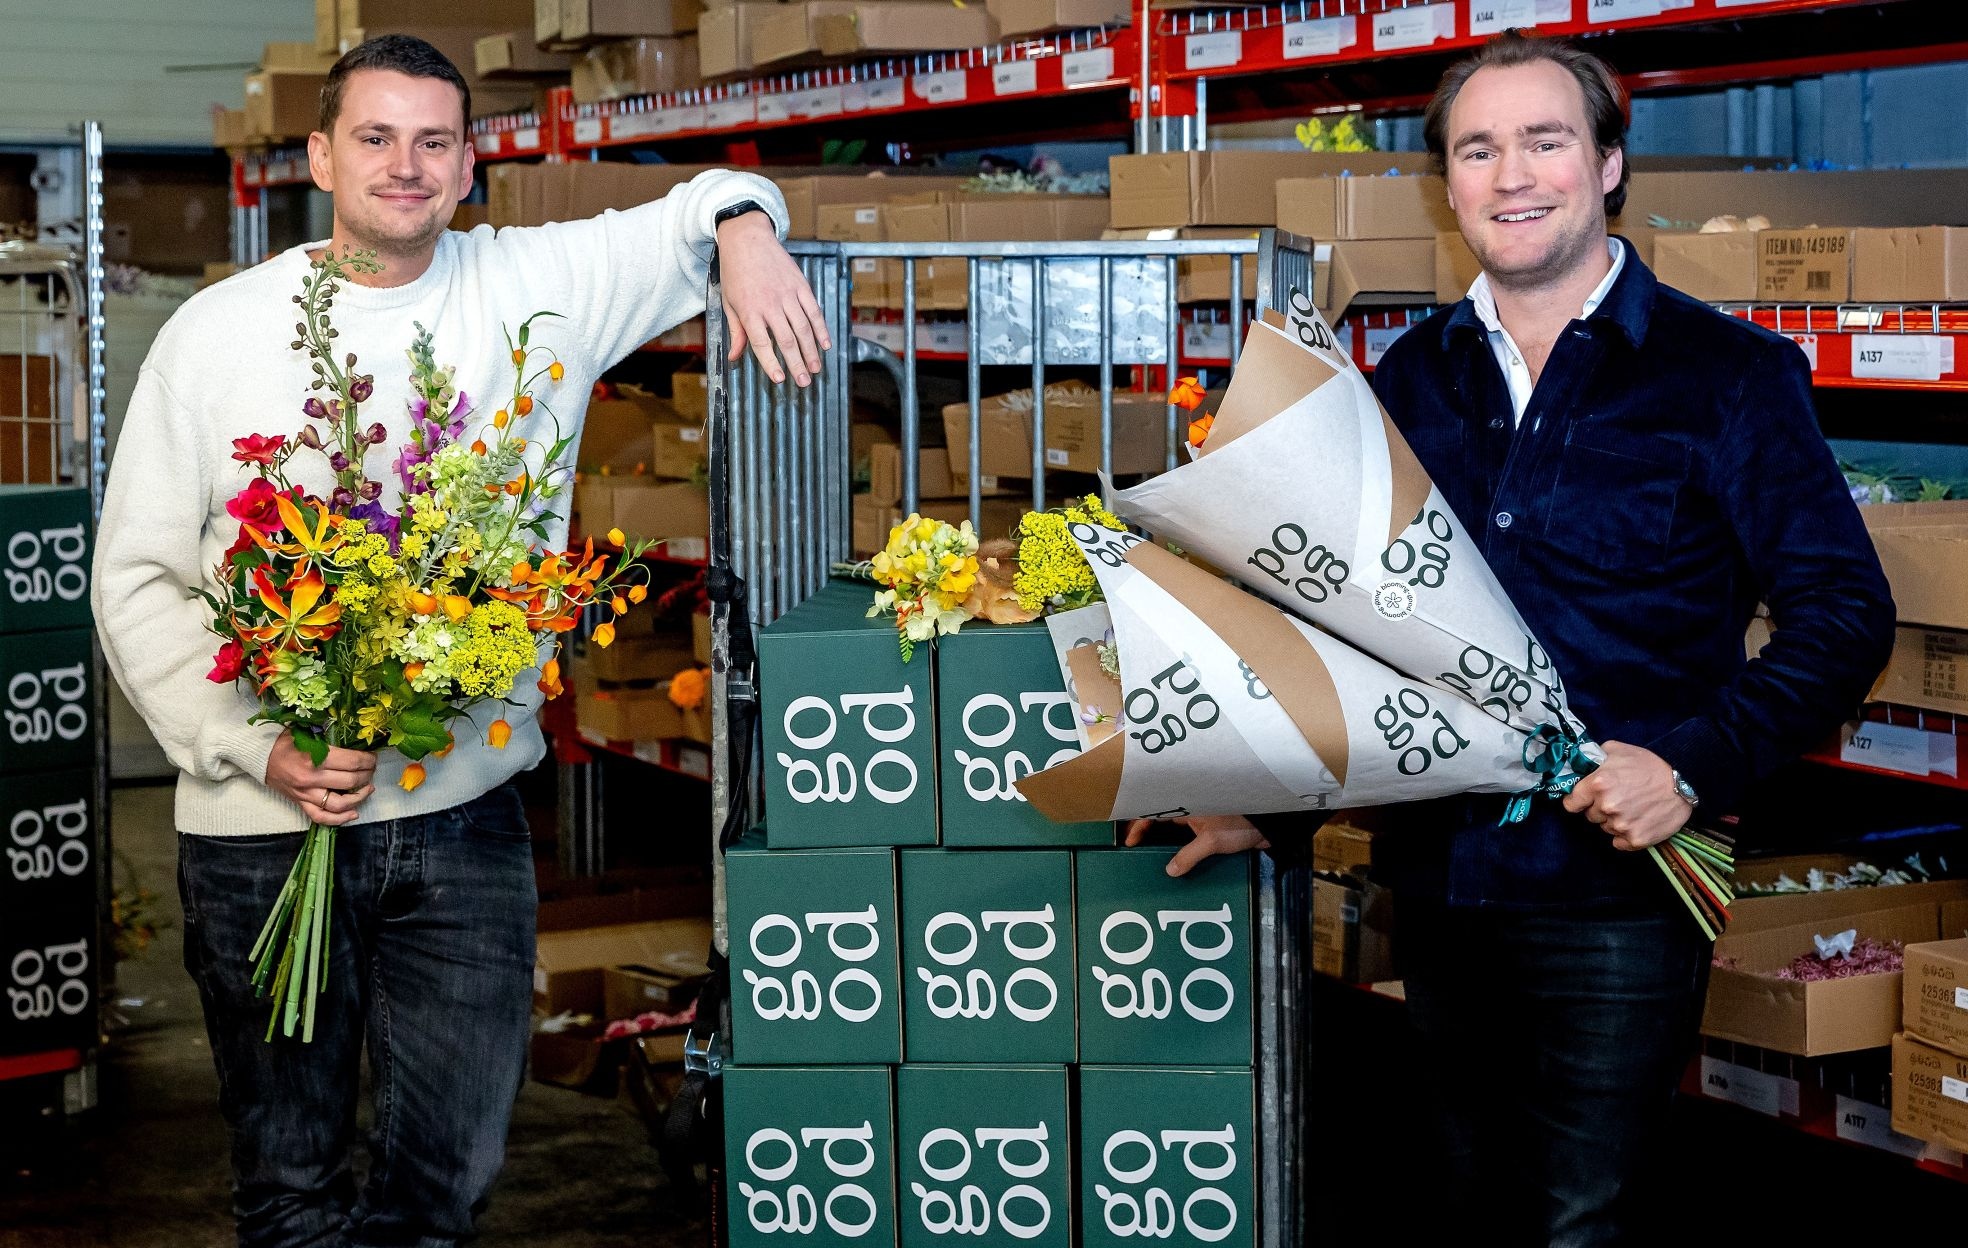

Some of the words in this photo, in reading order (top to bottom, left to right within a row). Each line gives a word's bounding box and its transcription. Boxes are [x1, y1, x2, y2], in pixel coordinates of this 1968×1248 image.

[1475, 11, 1494, 22] A144
[1765, 238, 1787, 254] ITEM
[1859, 351, 1883, 363] A137
[1380, 582, 1410, 594] blooming
[777, 695, 857, 804] go
[1848, 735, 1872, 750] A127
[742, 913, 823, 1021] go
[916, 911, 997, 1020] go
[1091, 910, 1173, 1020] go
[1844, 1112, 1867, 1131] A117
[738, 1127, 818, 1235] go
[910, 1127, 991, 1236] go
[1094, 1129, 1176, 1239] go
